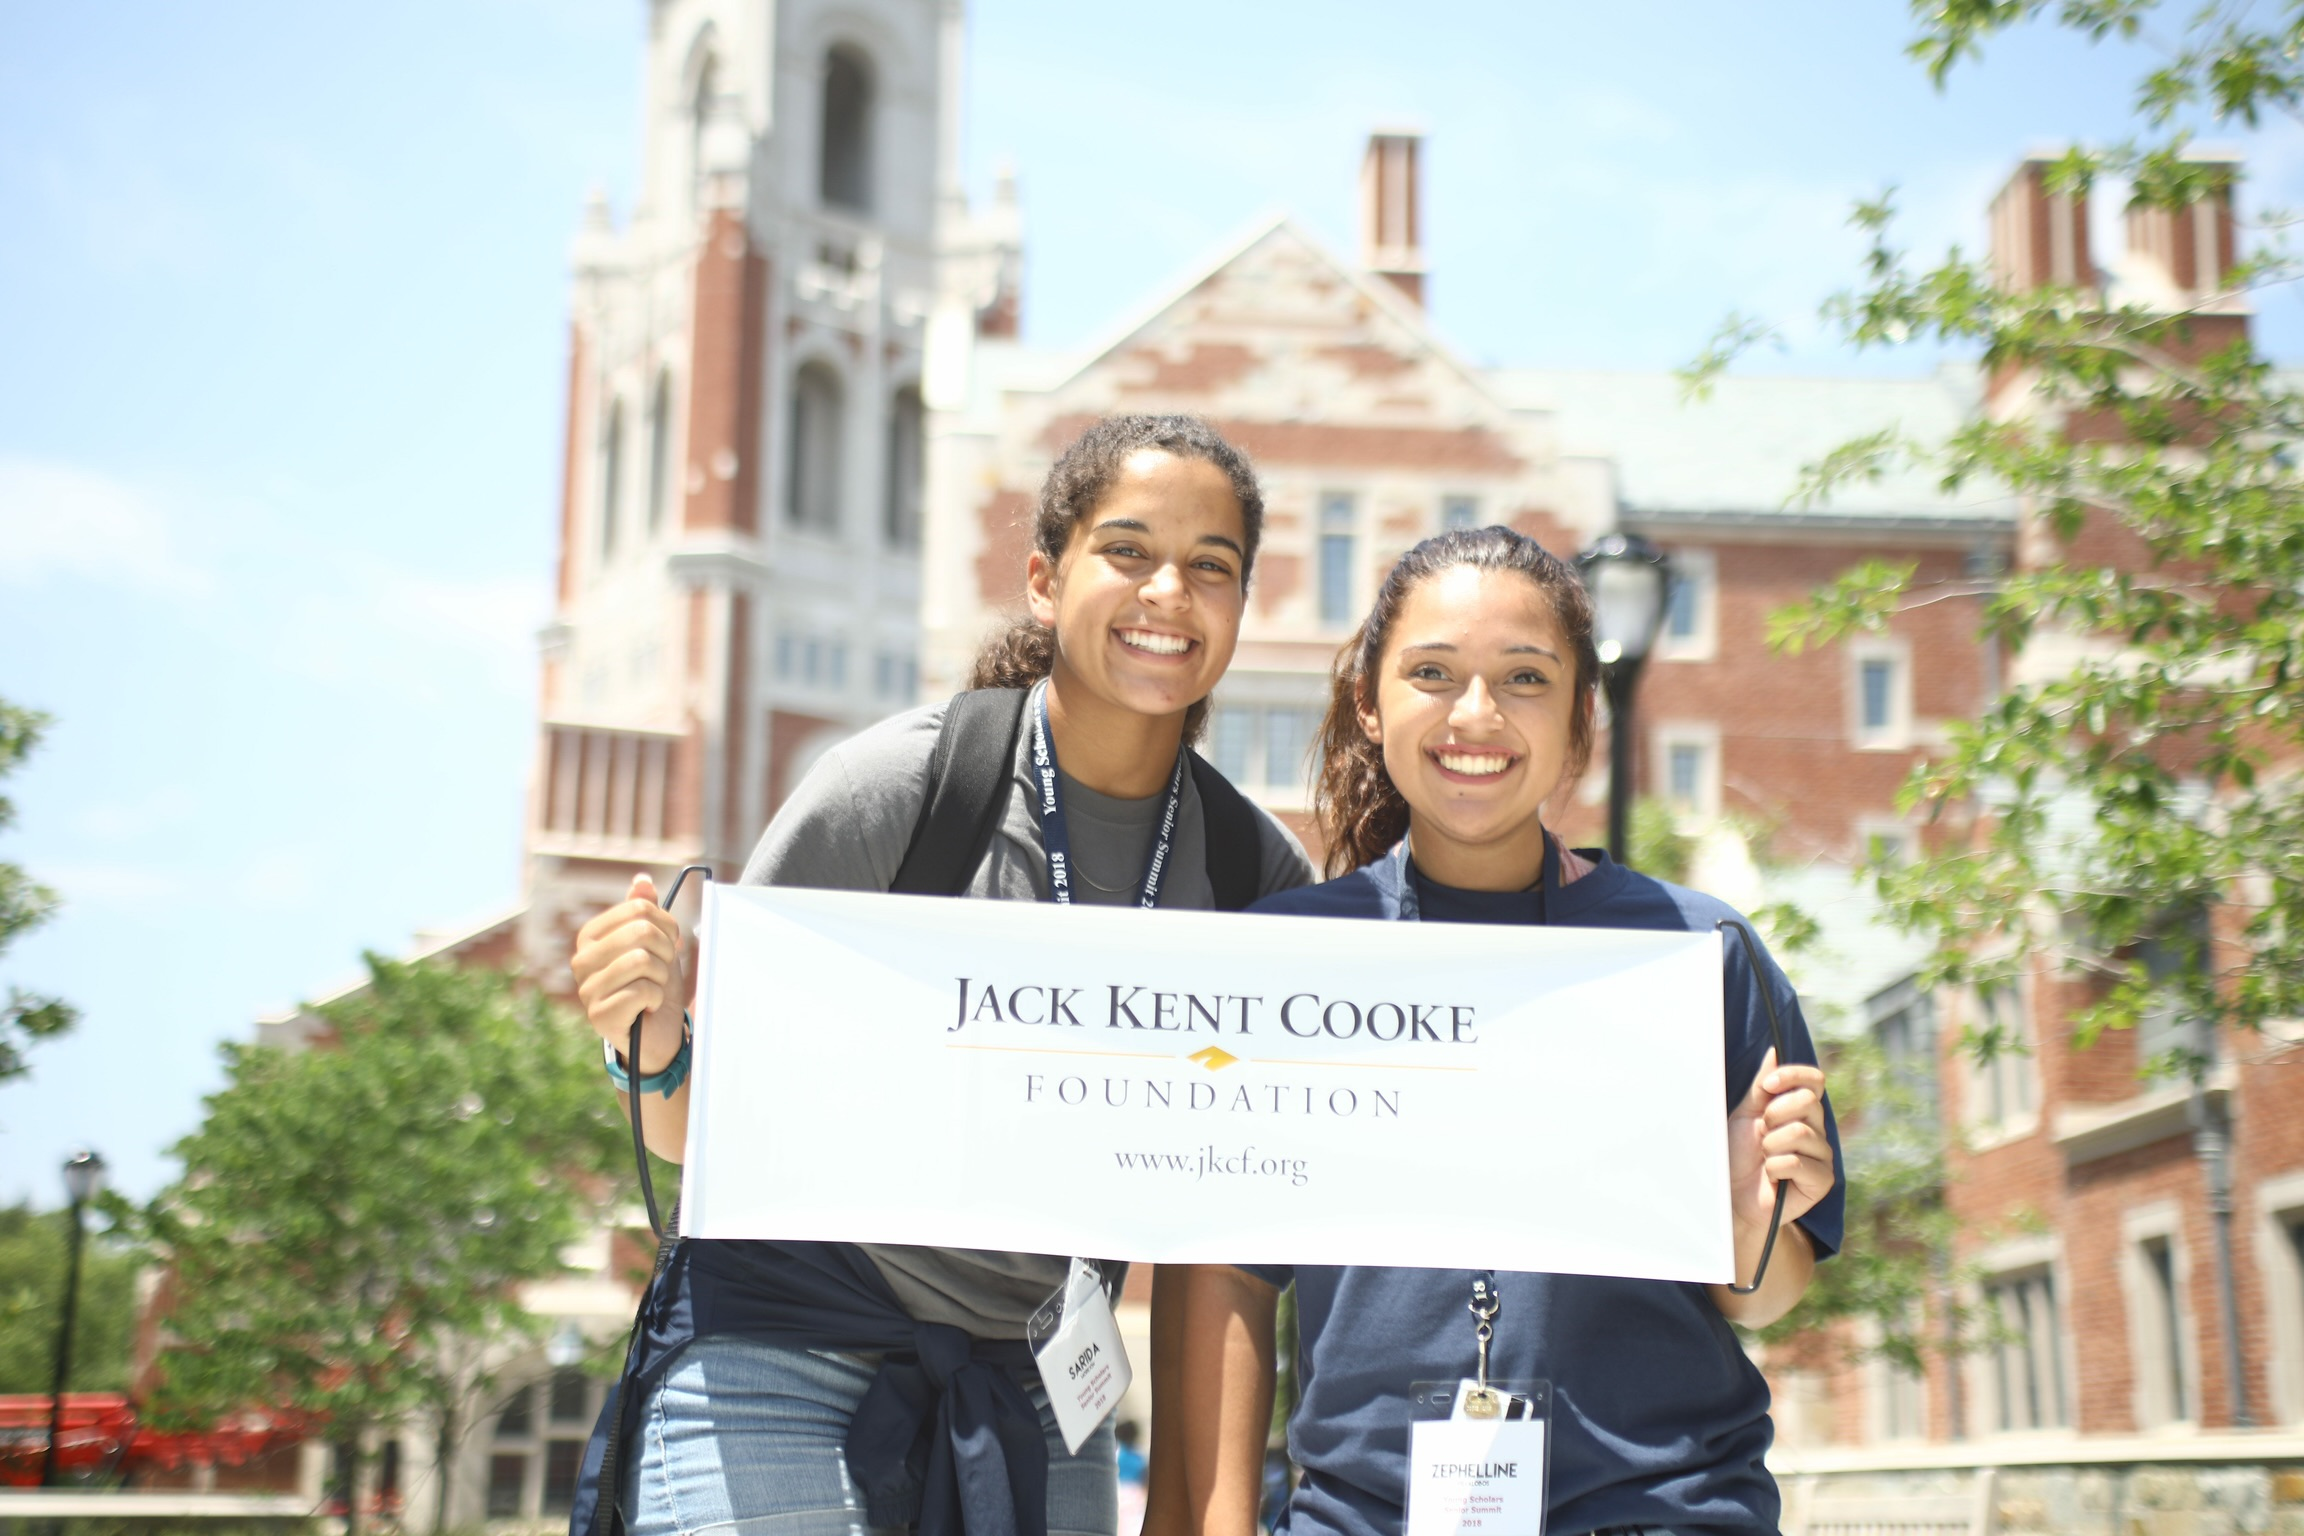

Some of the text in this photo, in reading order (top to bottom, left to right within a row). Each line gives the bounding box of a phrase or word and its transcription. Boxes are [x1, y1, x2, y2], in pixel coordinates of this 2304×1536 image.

[1041, 767, 1057, 816] Young
[1161, 796, 1179, 841] Senior
[1051, 851, 1068, 888] 2018
[1145, 840, 1169, 897] Summit
[947, 977, 1478, 1043] JACK KENT COOKE
[1026, 1074, 1400, 1118] FOUNDATION
[1115, 1145, 1309, 1186] www.jkcf.org
[1069, 1342, 1100, 1380] SARIDA
[1432, 1463, 1517, 1479] ZEPHELLINE
[1469, 1496, 1504, 1504] Scholars
[1471, 1506, 1502, 1514] Summit
[1462, 1519, 1482, 1527] 2018
